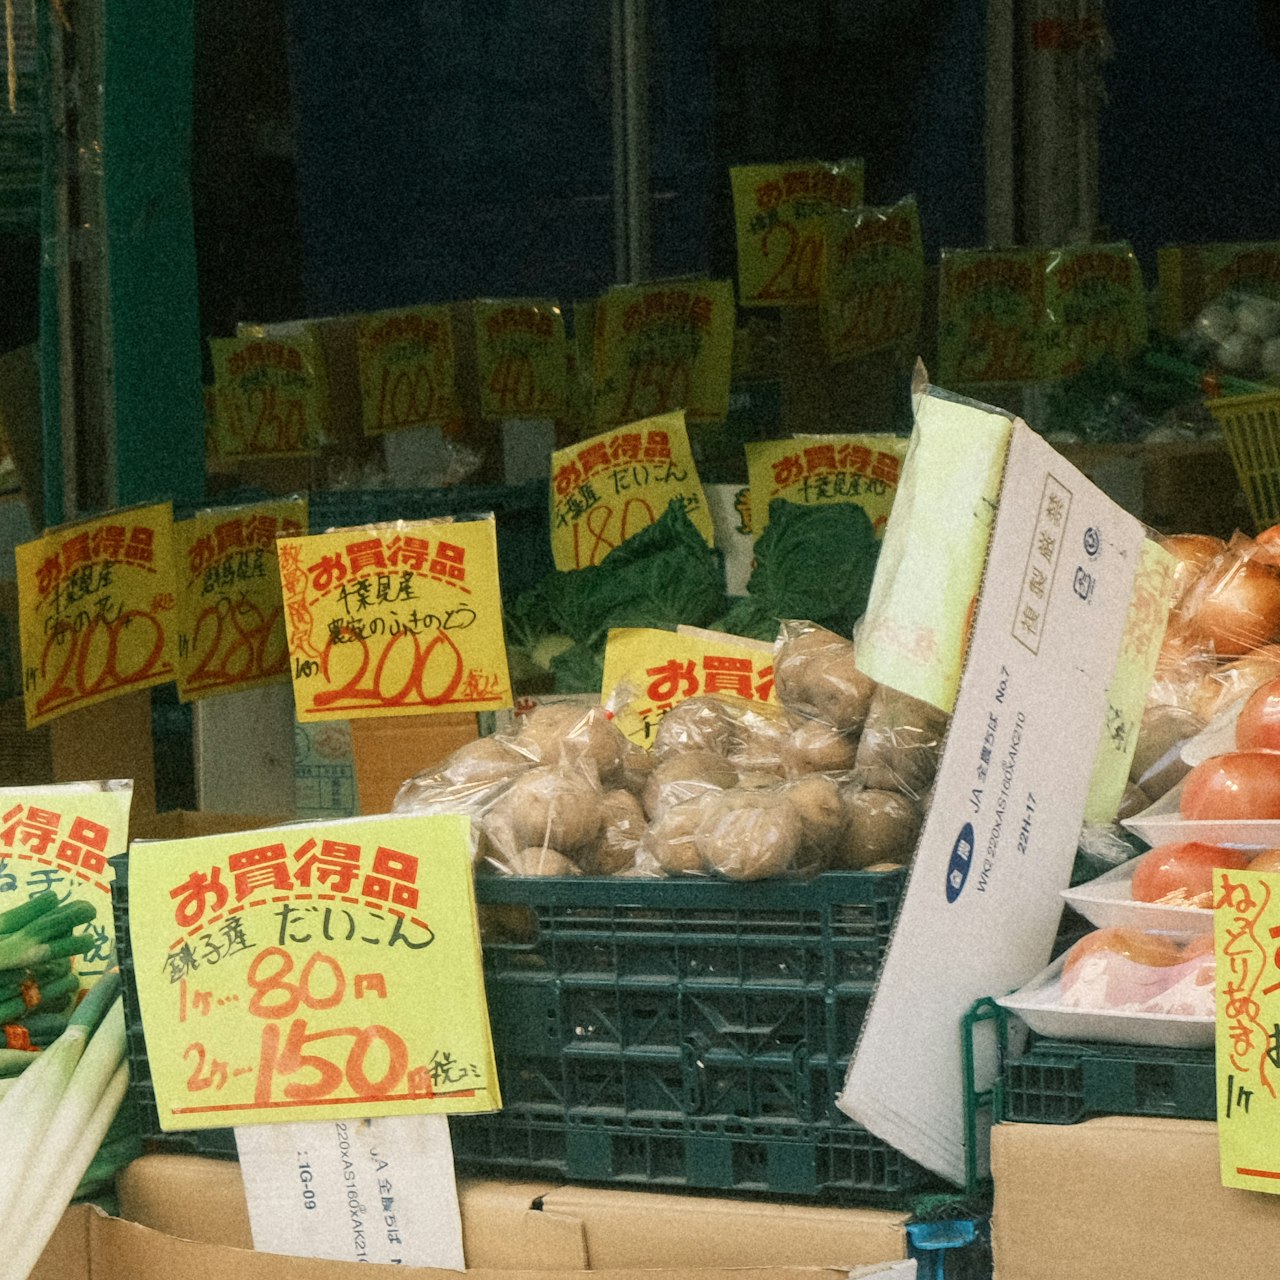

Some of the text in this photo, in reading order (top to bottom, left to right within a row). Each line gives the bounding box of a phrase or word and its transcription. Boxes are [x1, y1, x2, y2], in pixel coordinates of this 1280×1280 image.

[553, 431, 672, 496] お買得品
[772, 443, 900, 487] お買得品
[36, 524, 156, 595] お買得品
[307, 535, 466, 592] お買得品
[336, 570, 420, 615] 千葉県産
[41, 608, 165, 705] 200
[313, 626, 464, 707] 200
[969, 664, 1011, 814] JA 全農ちば No.7
[1016, 791, 1037, 856] 22H-17
[169, 838, 420, 929] お買得品
[275, 902, 434, 951] だいこん
[247, 946, 388, 1020] 80円
[297, 1151, 317, 1211] 1G-09
